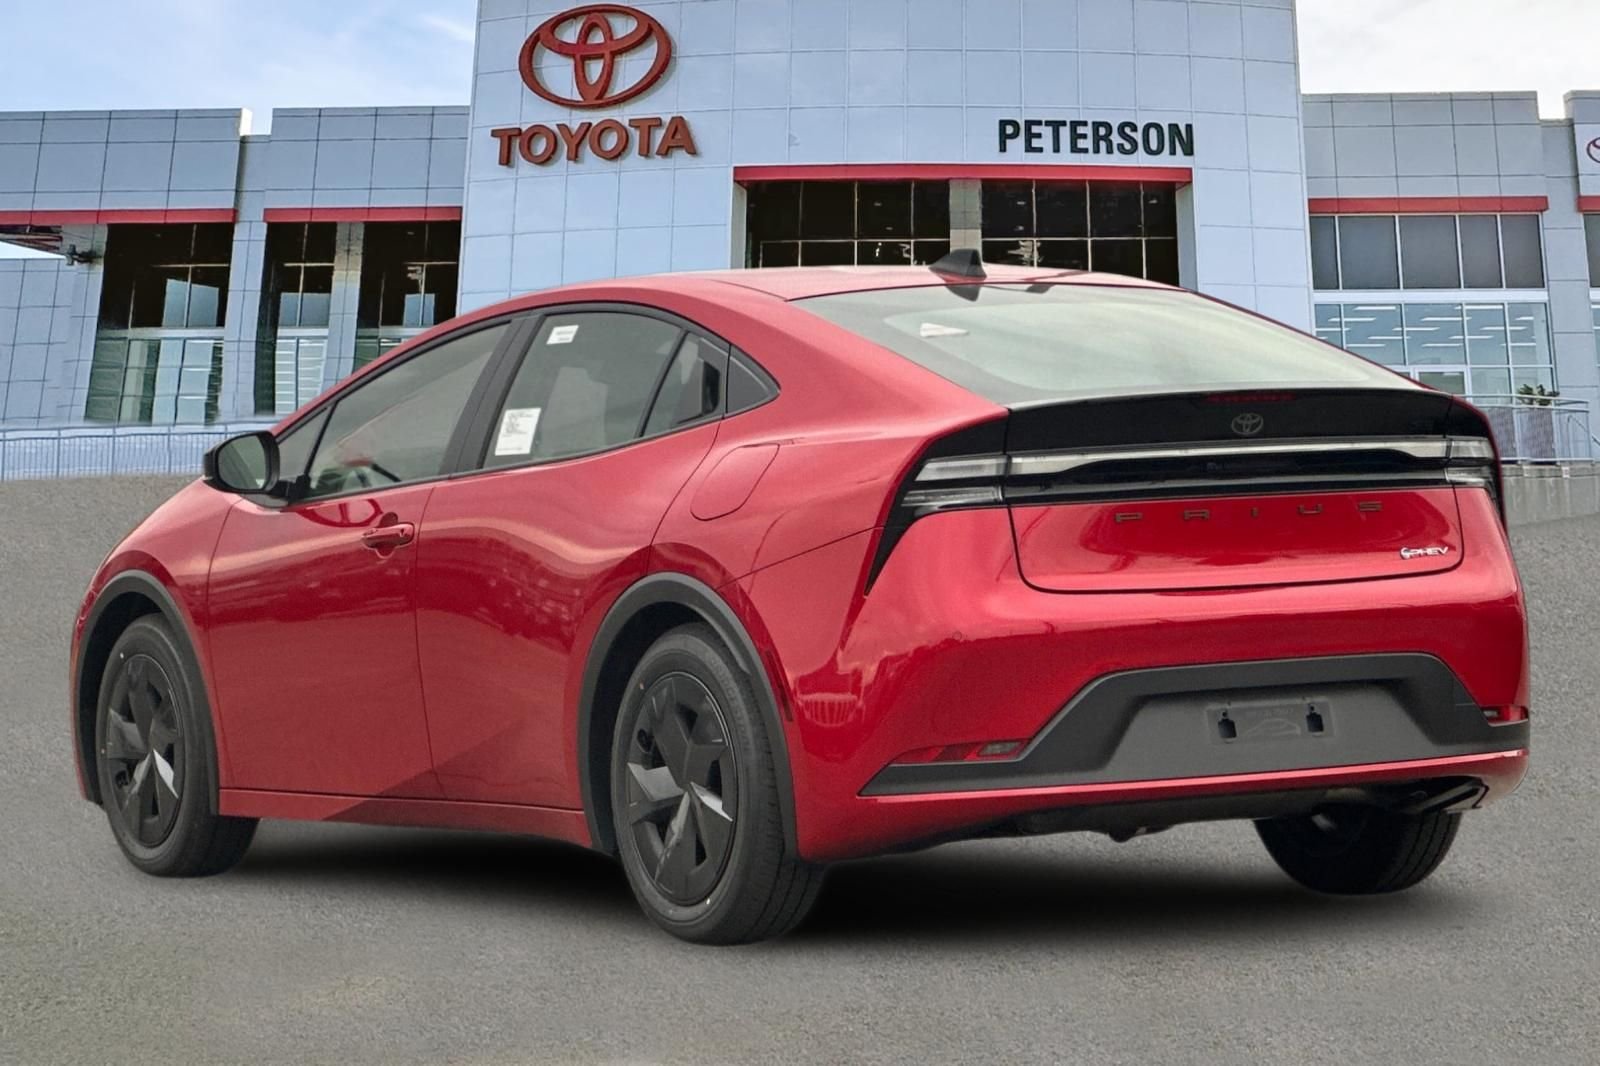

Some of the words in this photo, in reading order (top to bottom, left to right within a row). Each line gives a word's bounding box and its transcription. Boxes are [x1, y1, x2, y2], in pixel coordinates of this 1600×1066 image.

[491, 116, 697, 166] TOYOTA
[998, 119, 1194, 156] PETERSON
[1115, 500, 1383, 523] PRIUS
